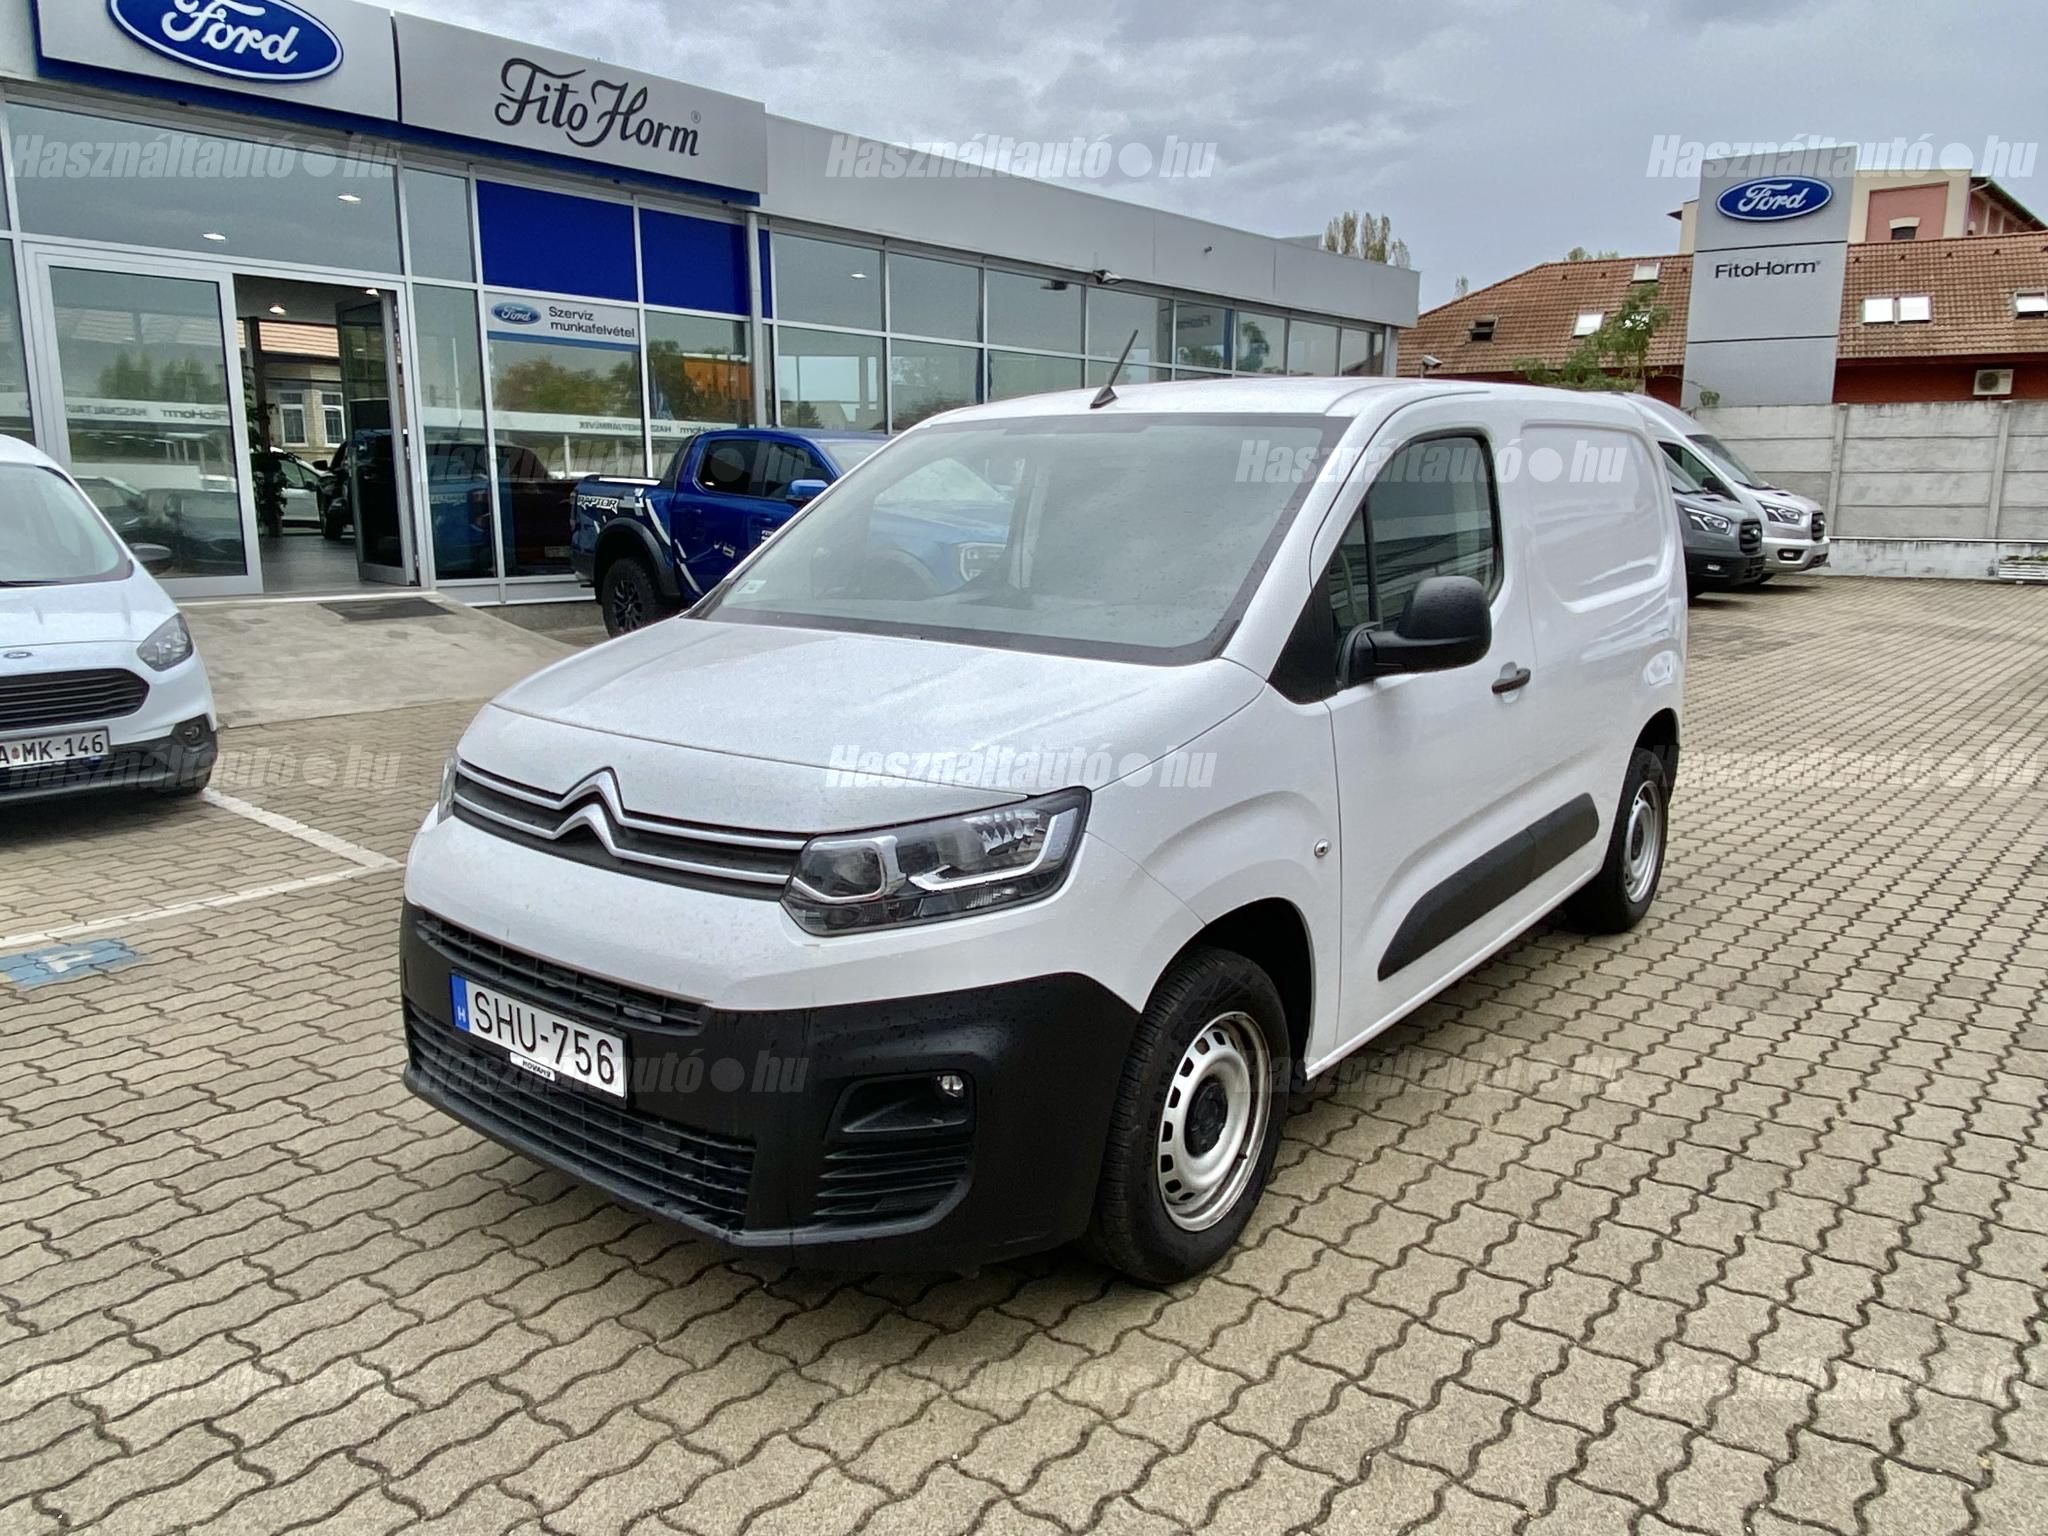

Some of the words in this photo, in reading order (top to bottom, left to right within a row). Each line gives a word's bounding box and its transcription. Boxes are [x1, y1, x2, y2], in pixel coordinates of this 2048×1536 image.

[162, 0, 300, 64] Ford
[1738, 183, 1810, 212] Ford
[501, 307, 531, 322] Ford
[548, 306, 594, 321] Szerviz
[550, 321, 635, 338] munkafelvétel
[577, 495, 619, 514] RAPTOR
[457, 1006, 466, 1023] H
[474, 991, 615, 1085] SHU-756
